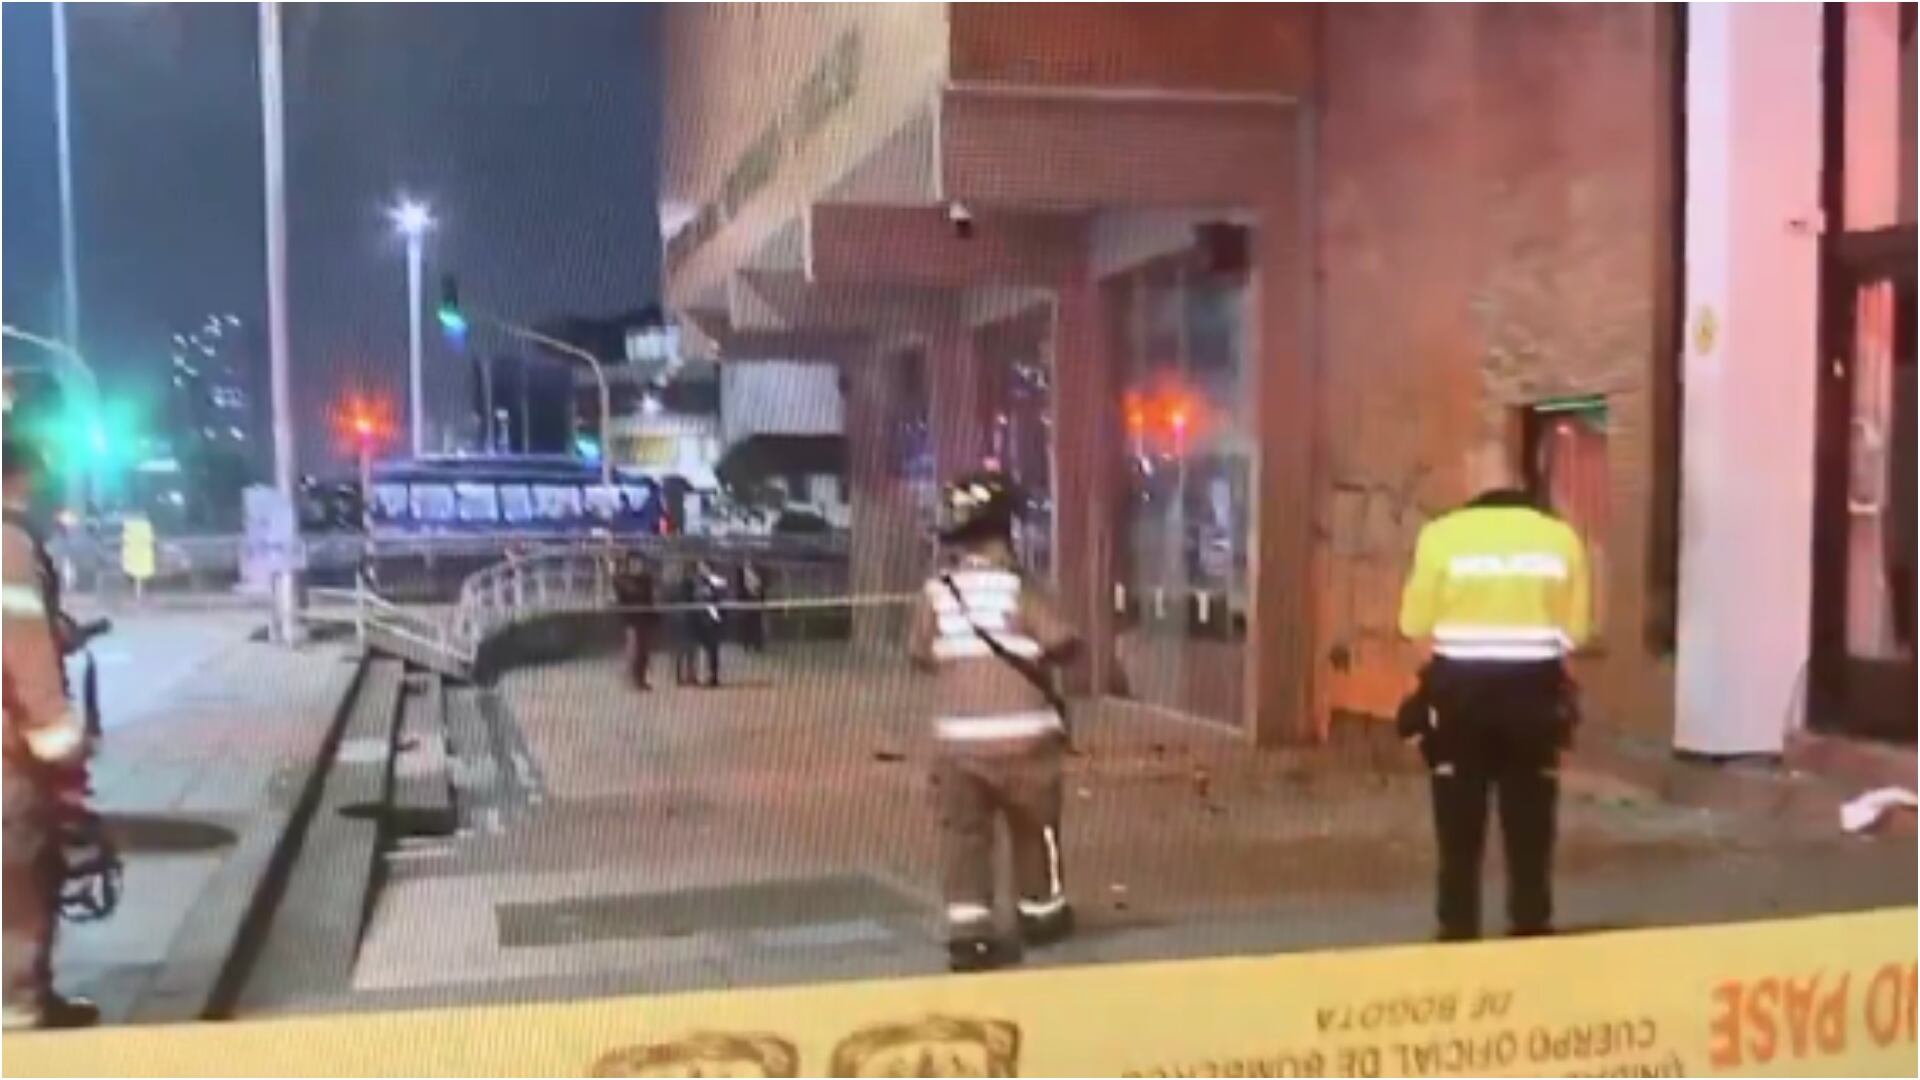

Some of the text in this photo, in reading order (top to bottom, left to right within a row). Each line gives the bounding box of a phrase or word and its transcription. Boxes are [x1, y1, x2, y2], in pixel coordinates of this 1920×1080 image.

[1317, 991, 1514, 1030] DE BOGOTA
[1709, 962, 1918, 1069] O PASE
[1340, 1047, 1381, 1077] DE
[1394, 1031, 1518, 1076] OFICIAL
[1528, 1020, 1657, 1064] CUERPO
